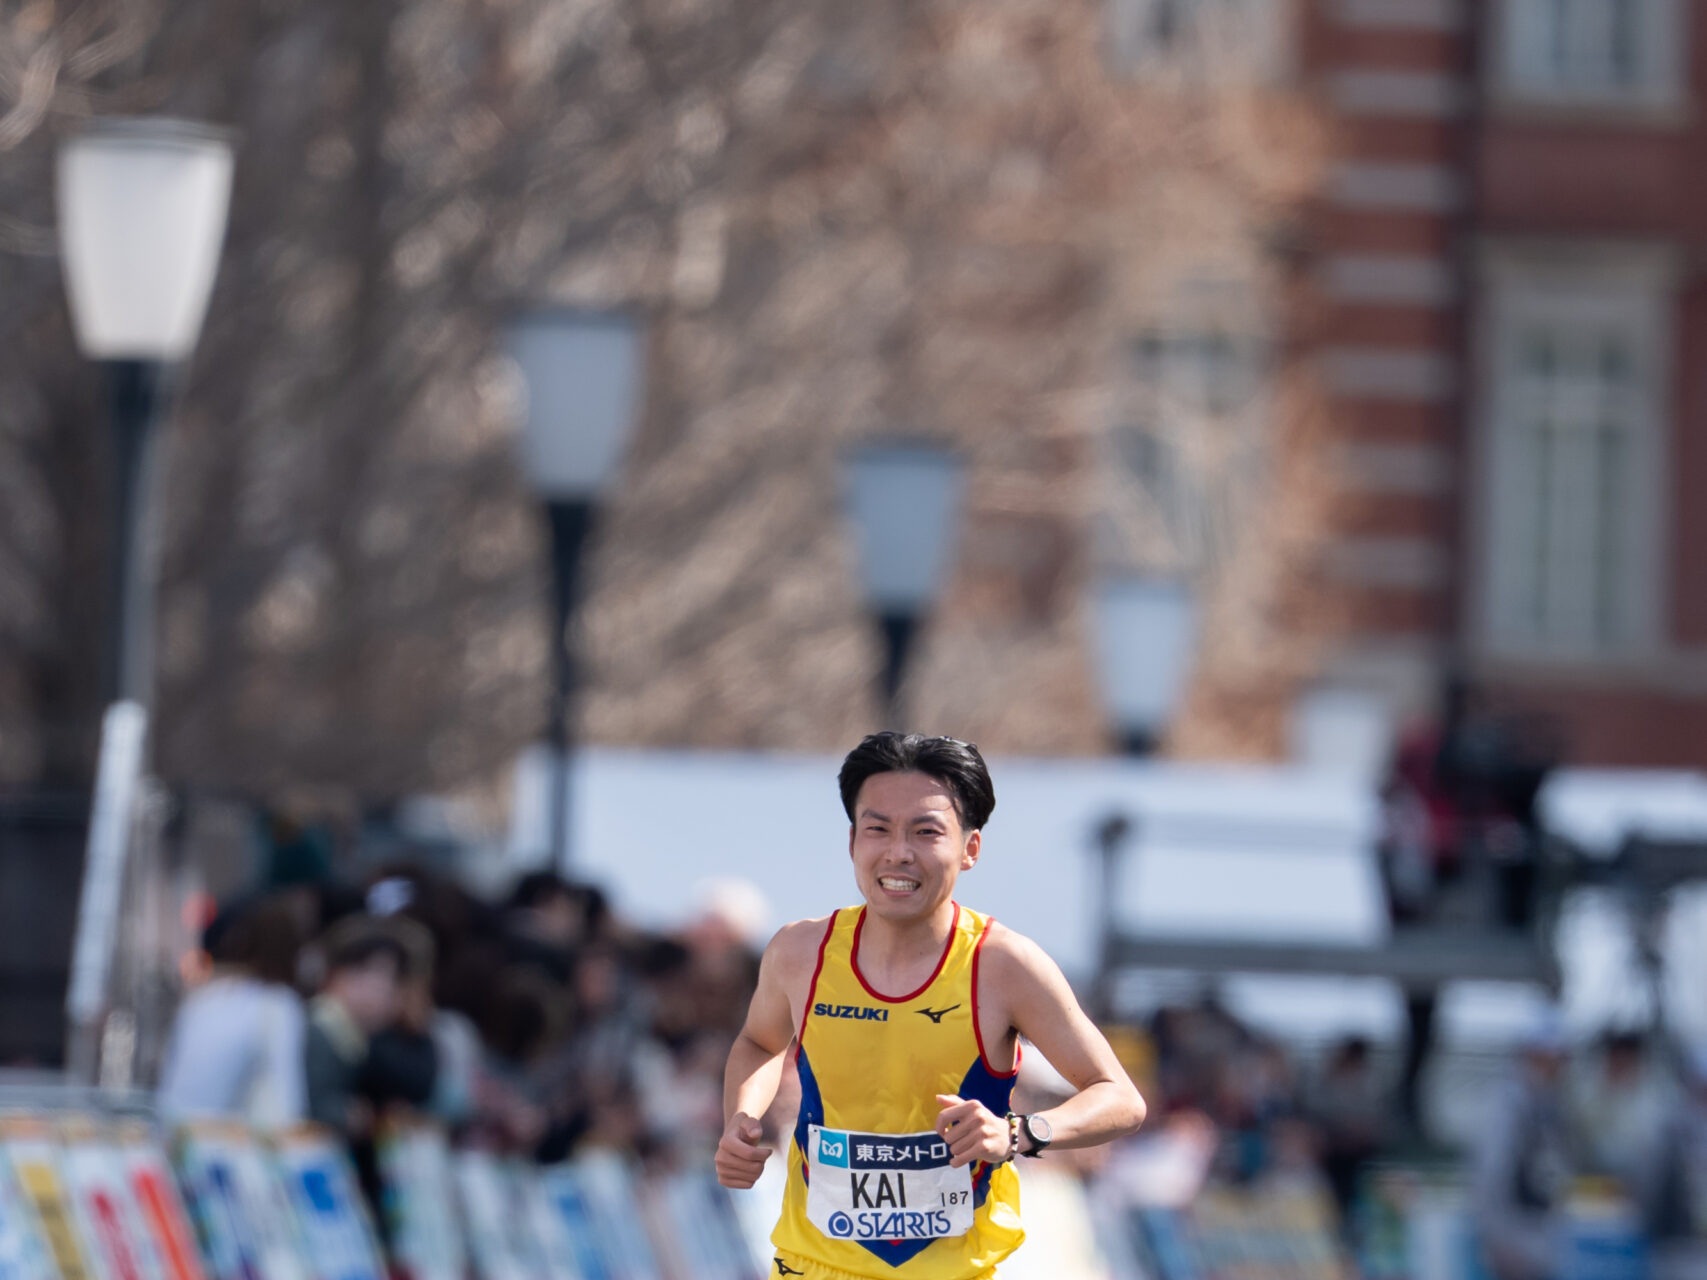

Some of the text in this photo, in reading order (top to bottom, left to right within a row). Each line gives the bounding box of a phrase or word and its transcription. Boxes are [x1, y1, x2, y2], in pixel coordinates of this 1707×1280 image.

[814, 1003, 888, 1021] SUZUKI
[855, 1142, 947, 1162] 東京メトロ
[851, 1172, 907, 1208] KAI
[941, 1190, 969, 1207] 187
